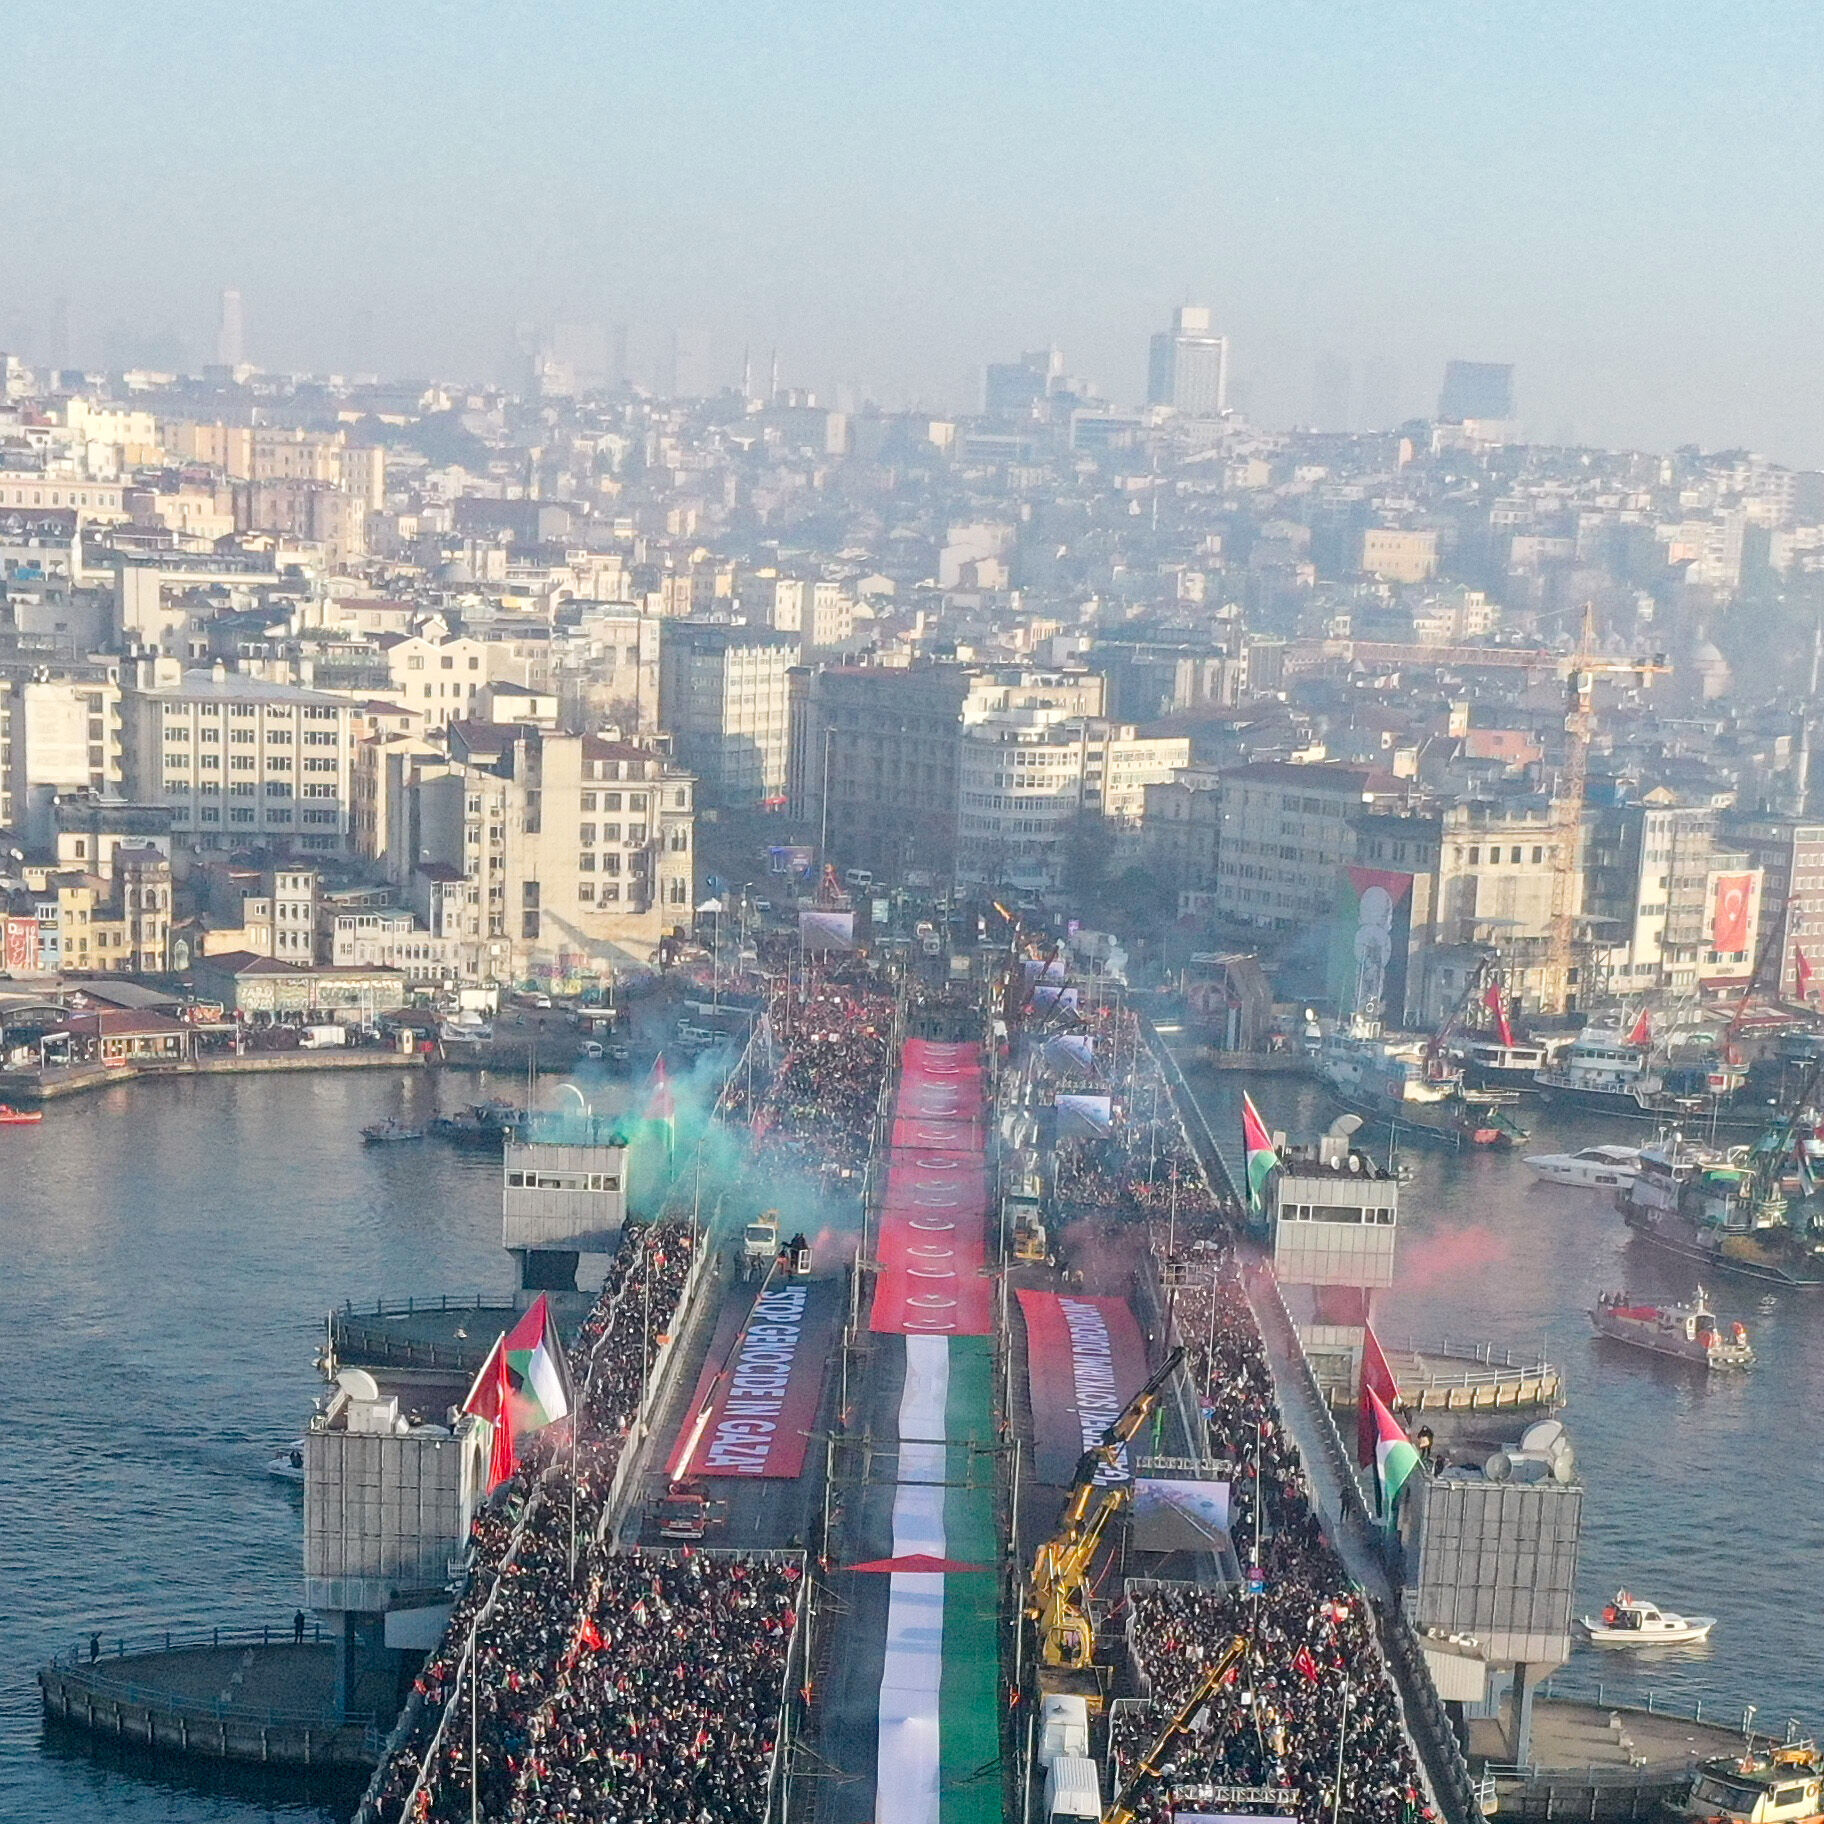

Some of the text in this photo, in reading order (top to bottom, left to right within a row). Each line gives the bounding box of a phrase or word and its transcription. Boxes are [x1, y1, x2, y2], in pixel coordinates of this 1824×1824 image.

[1058, 1298, 1111, 1355] DURDURUN"
[705, 1286, 808, 1473] "STOP GENOCIDE IN GAZA"
[1073, 1354, 1119, 1409] SOYKIRIMI
